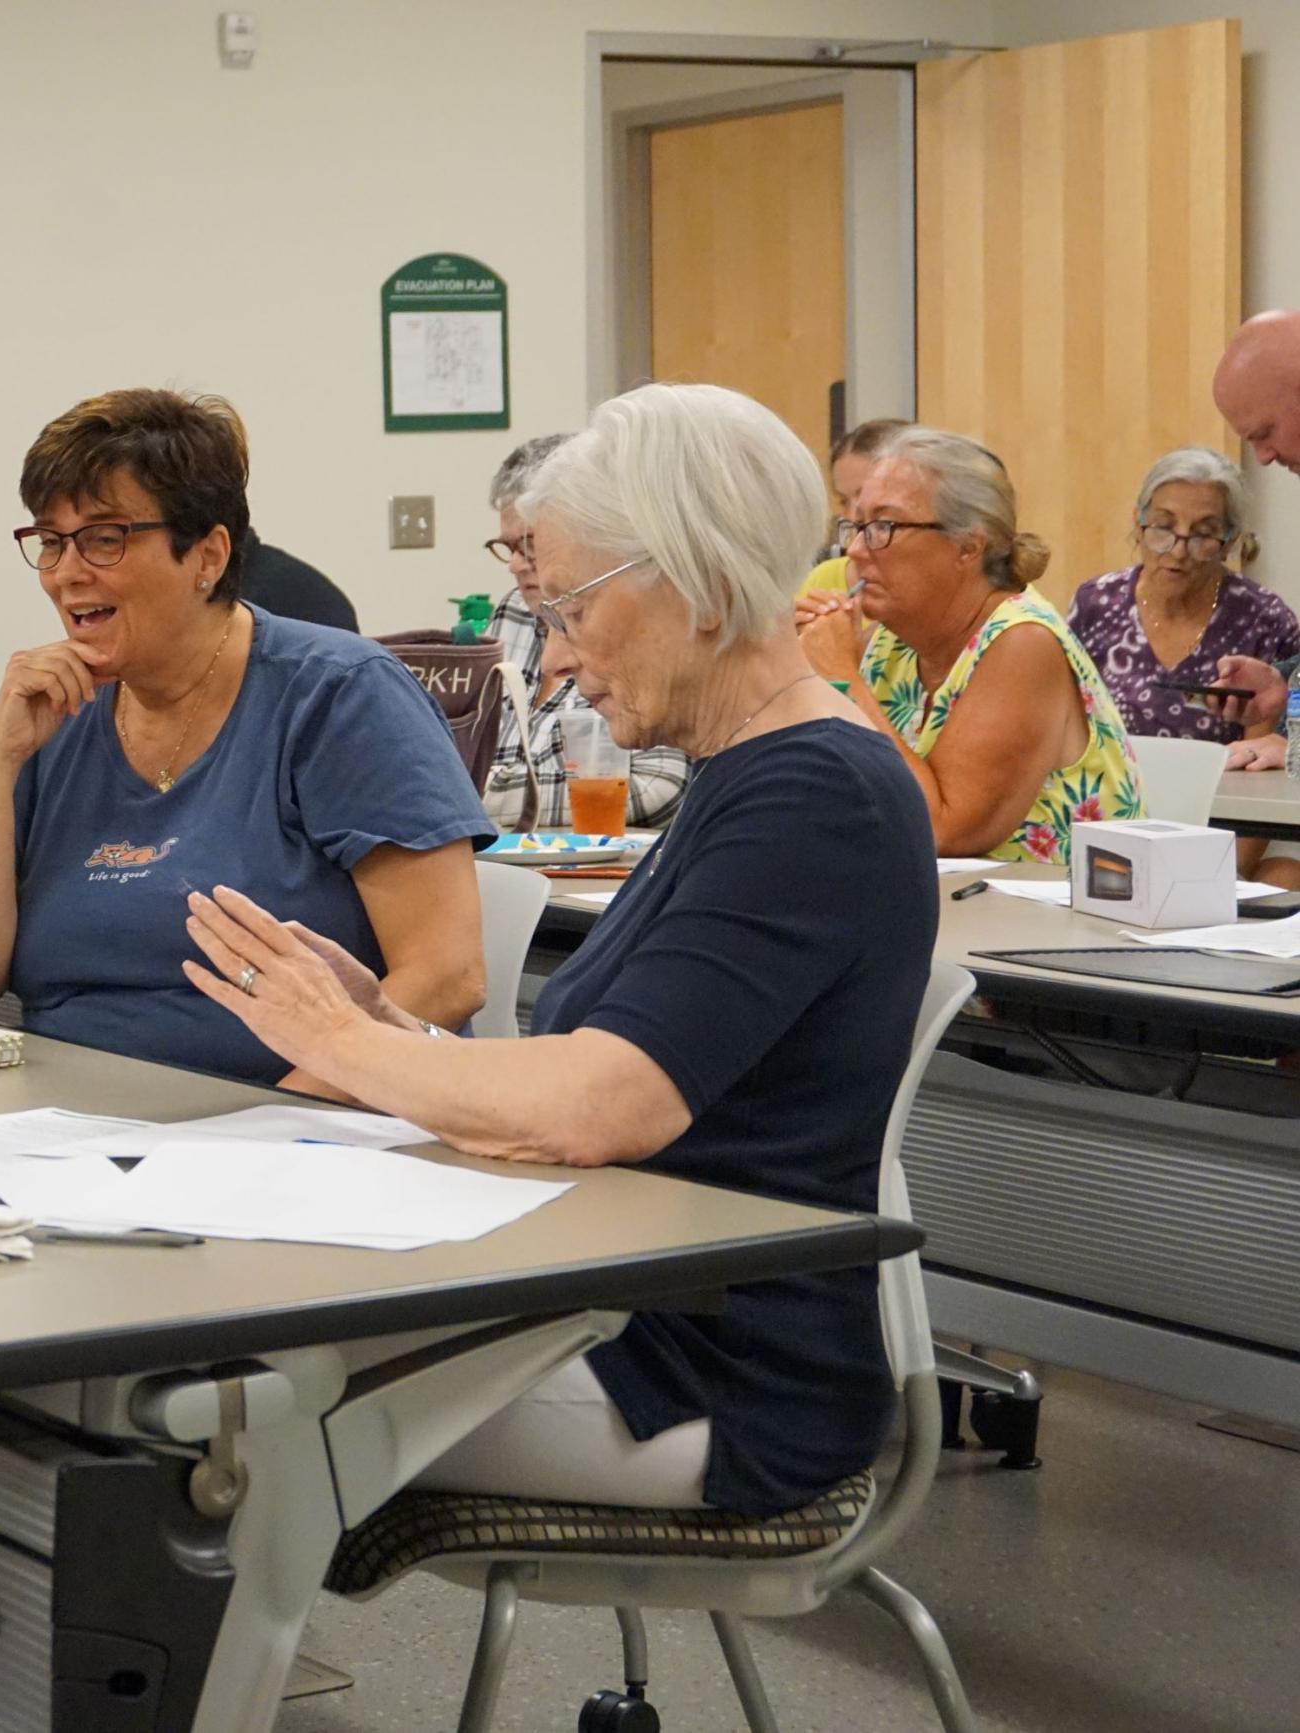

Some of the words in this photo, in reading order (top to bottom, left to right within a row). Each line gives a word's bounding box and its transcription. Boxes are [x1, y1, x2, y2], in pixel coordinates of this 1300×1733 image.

[394, 279, 464, 293] EVACUATION
[466, 278, 495, 290] PLAN
[88, 871, 109, 881] Life
